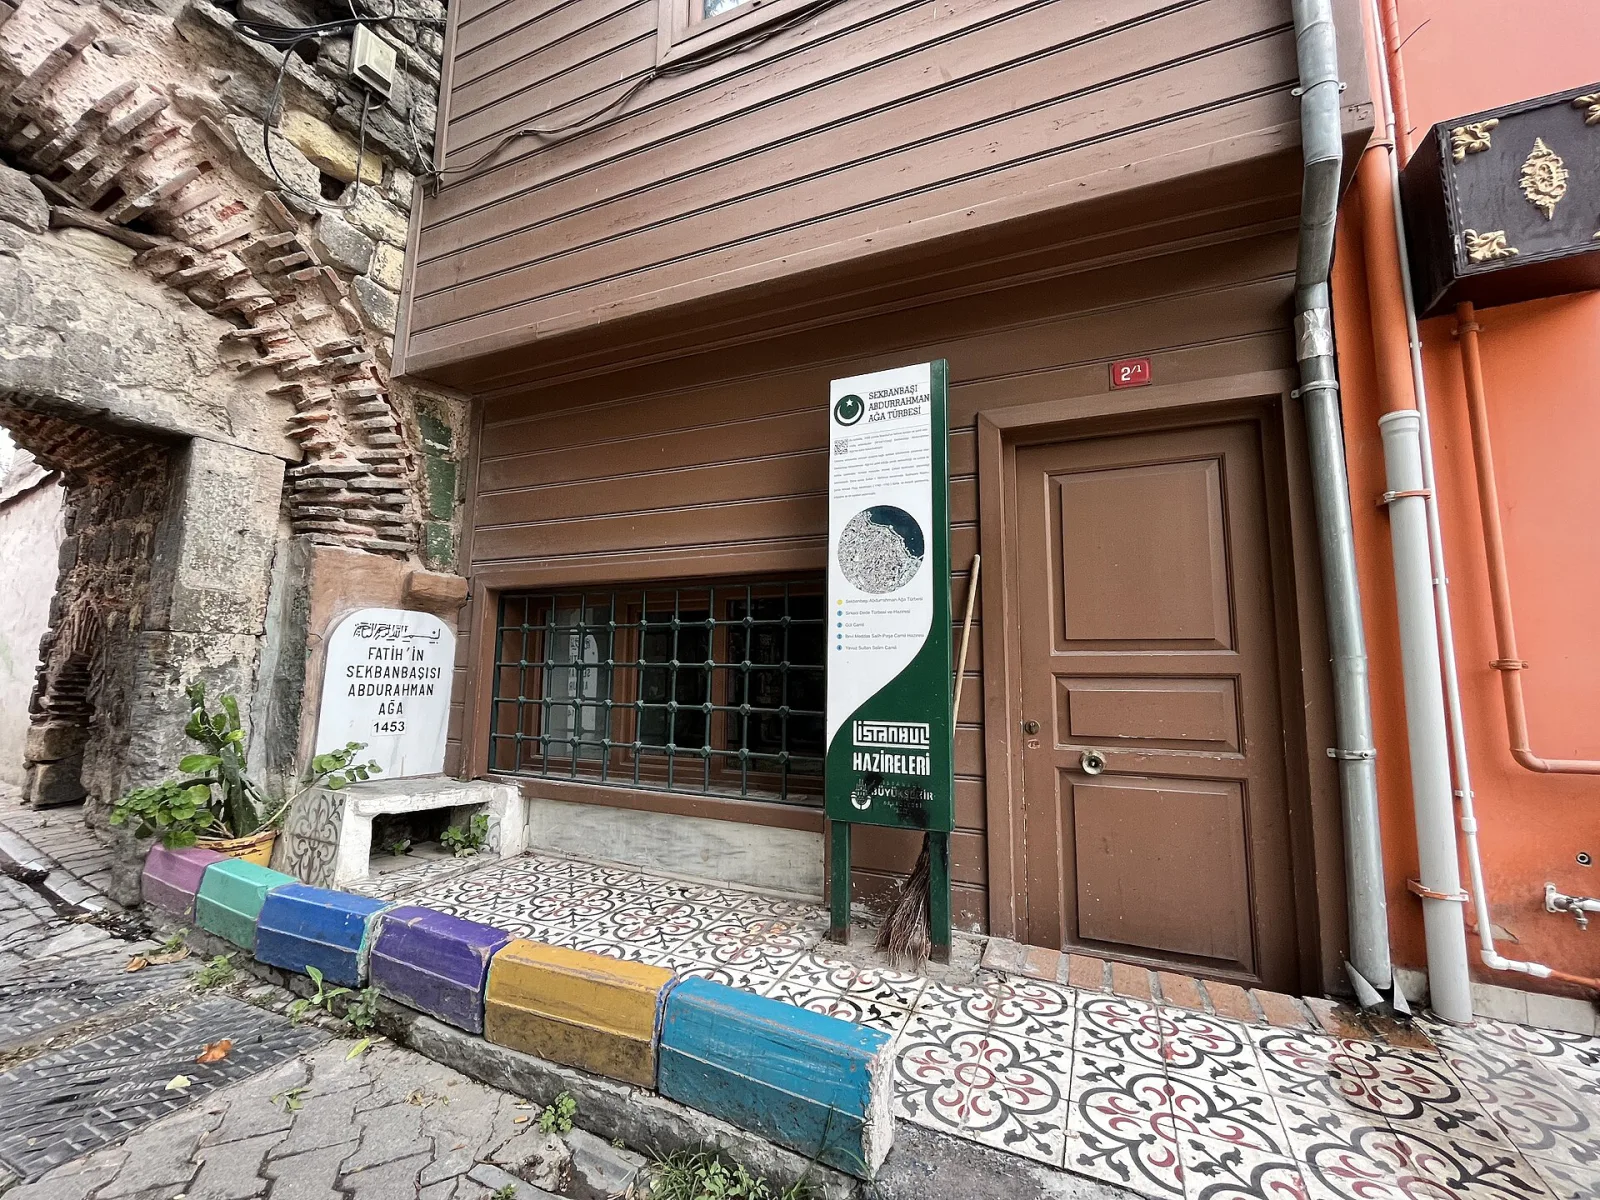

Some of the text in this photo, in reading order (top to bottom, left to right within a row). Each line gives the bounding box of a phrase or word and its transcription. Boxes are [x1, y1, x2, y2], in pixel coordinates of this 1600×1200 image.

[868, 384, 918, 400] SEKBANBAŞI
[868, 394, 930, 411] ABDURRAHMAN
[868, 406, 921, 422] AĞA TÜRBESİ
[346, 665, 441, 680] SEKBANBAŞISI
[347, 683, 434, 697] ABDURAHMAN
[378, 700, 403, 715] AĞA
[373, 721, 405, 733] 1453
[853, 749, 930, 776] HAZİRELERİ
